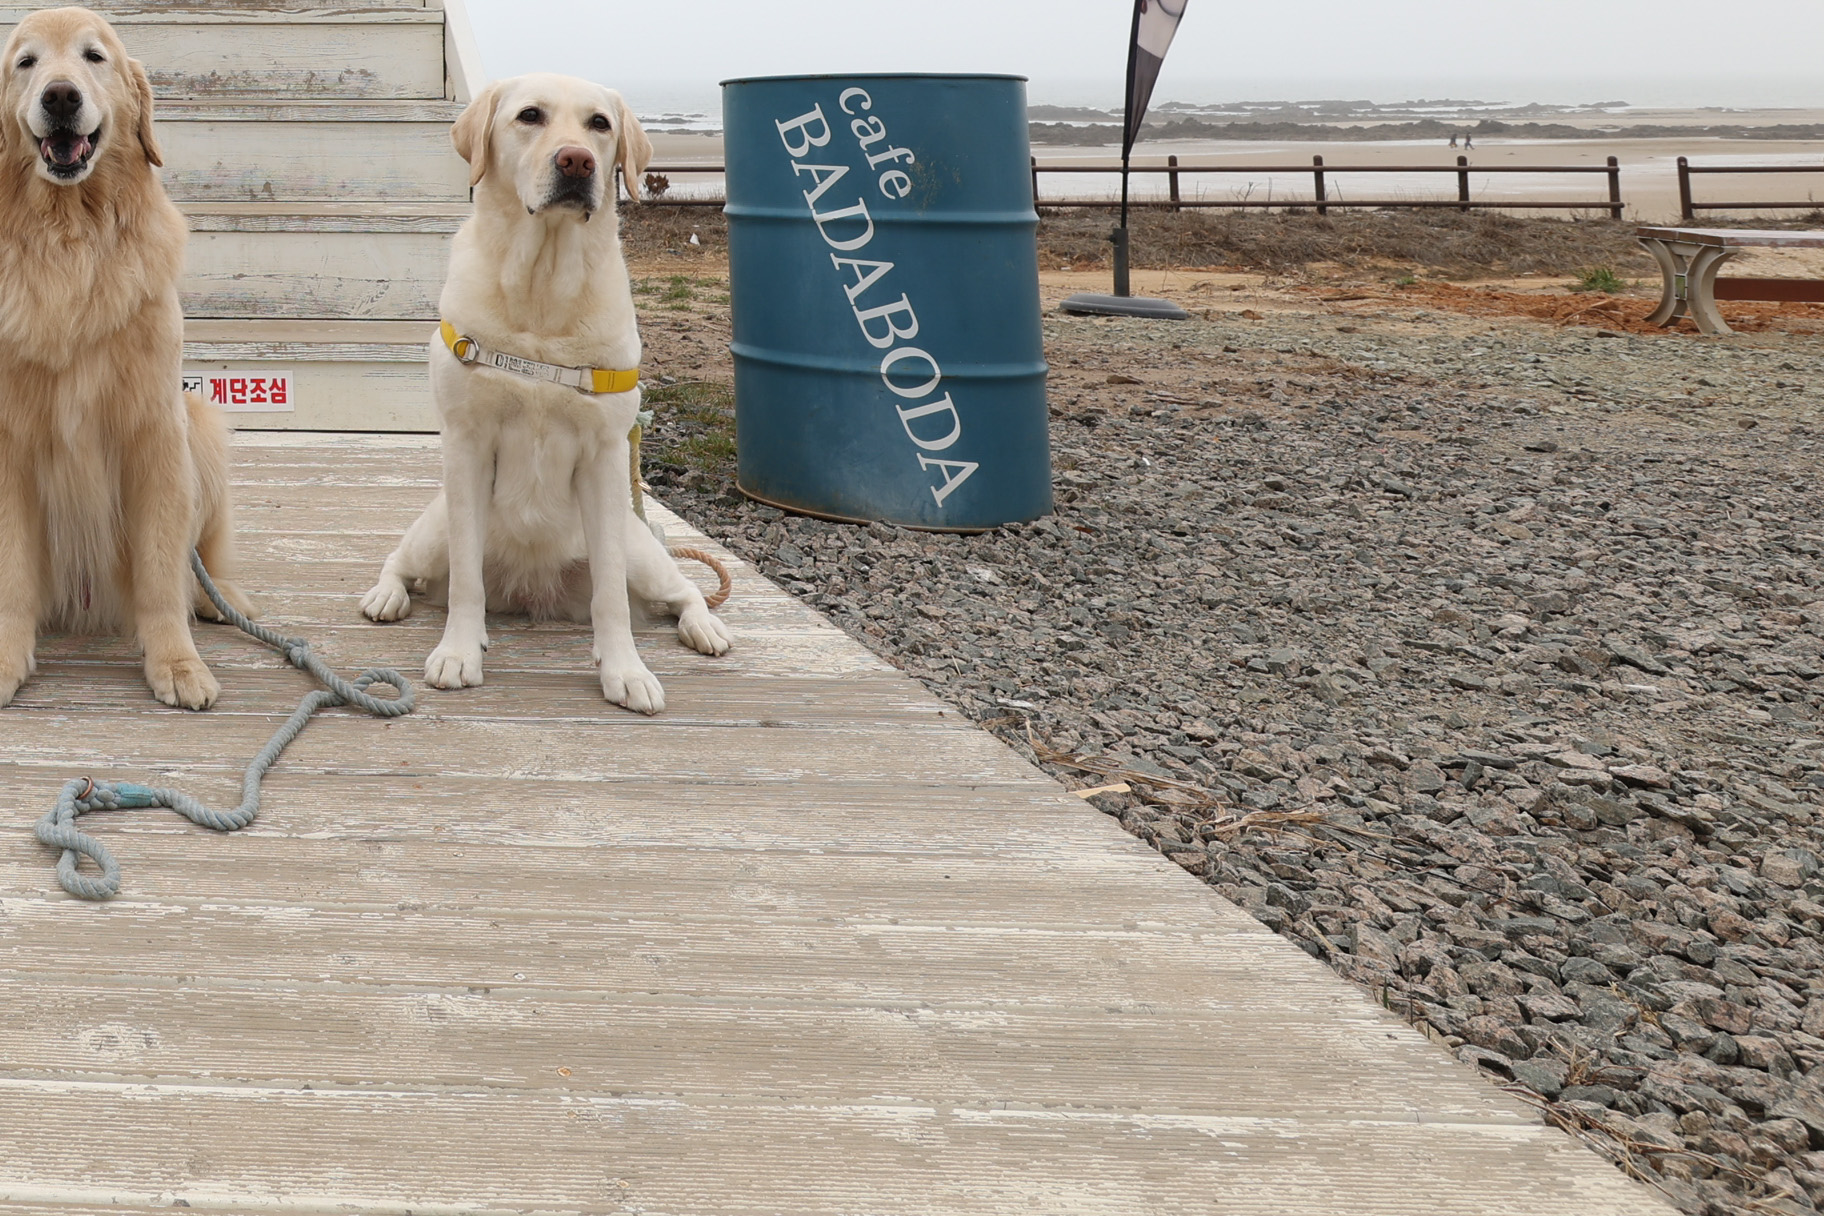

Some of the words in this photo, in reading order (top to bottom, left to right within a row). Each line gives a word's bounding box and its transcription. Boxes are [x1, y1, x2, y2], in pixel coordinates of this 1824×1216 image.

[838, 87, 915, 200] cafe
[775, 102, 979, 508] BADABODA
[209, 377, 287, 404] 계단조심
